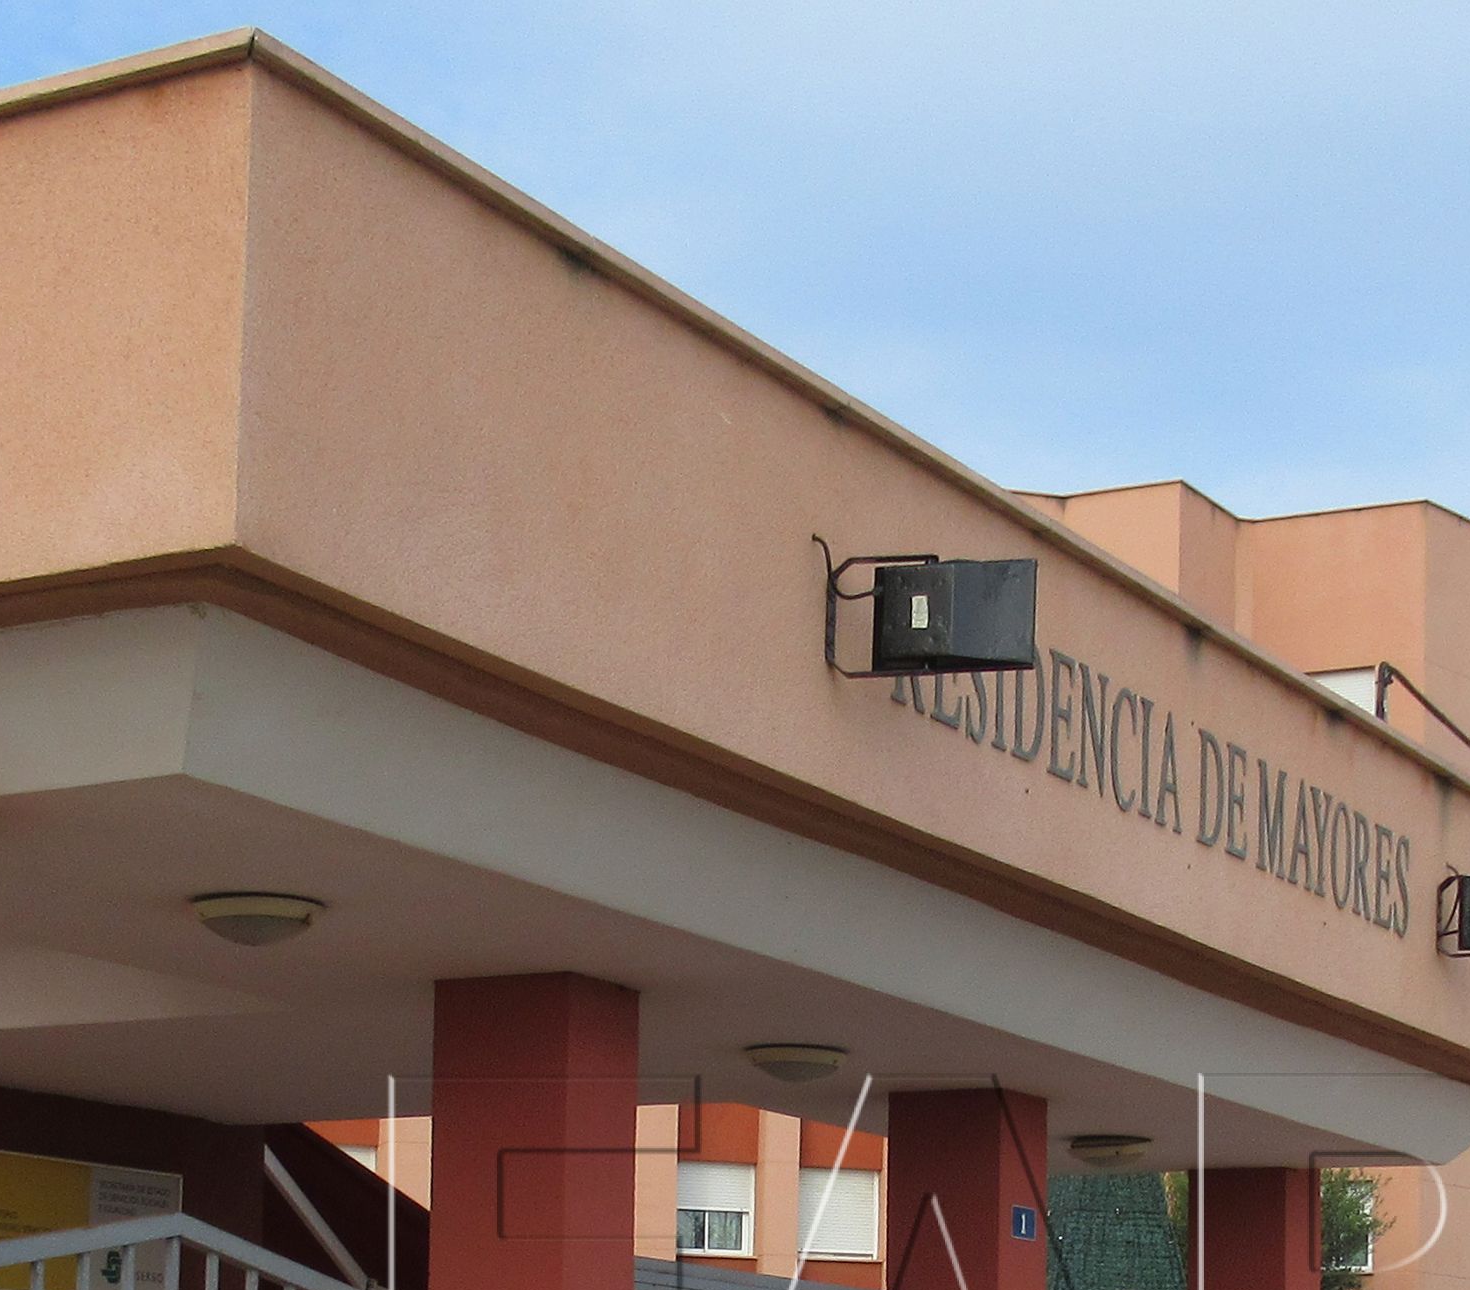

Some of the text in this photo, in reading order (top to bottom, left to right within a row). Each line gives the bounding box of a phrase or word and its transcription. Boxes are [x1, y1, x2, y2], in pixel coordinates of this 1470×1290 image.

[891, 643, 1411, 939] SIDENCIA DE MAYORES
[1020, 1213, 1027, 1235] 1
